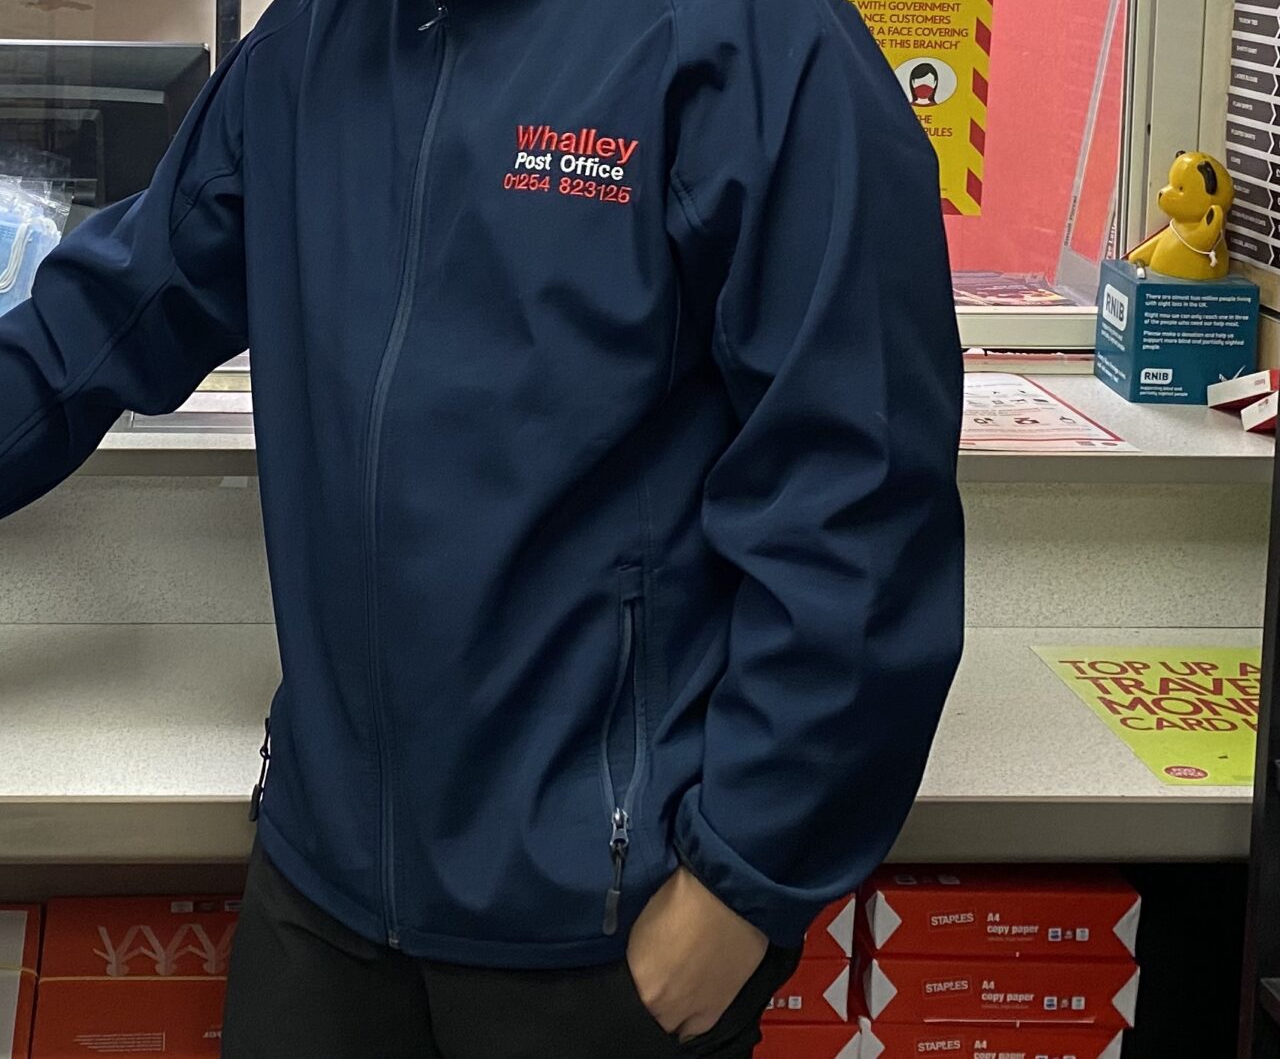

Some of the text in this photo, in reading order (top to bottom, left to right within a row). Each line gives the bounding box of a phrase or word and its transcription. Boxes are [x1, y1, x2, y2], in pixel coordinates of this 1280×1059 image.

[858, 0, 961, 13] WITH GOVERNMENT
[890, 14, 952, 25] CUSTOMERS
[887, 27, 913, 37] FACE
[915, 27, 969, 38] COVERING
[889, 38, 911, 49] THIS
[516, 125, 639, 164] Whalley
[514, 151, 624, 181] Post Office
[503, 173, 632, 204] 01254 823125
[1105, 292, 1125, 323] RNIB
[1144, 371, 1169, 381] RNIB
[1058, 660, 1220, 677] TOP UP
[1120, 717, 1238, 732] CARD
[931, 912, 1000, 927] STAPLES A4
[986, 924, 1039, 937] copy paper
[925, 980, 995, 993] STAPLES A4
[981, 992, 1035, 1004] copy paper
[917, 1039, 988, 1052] STAPLES A4
